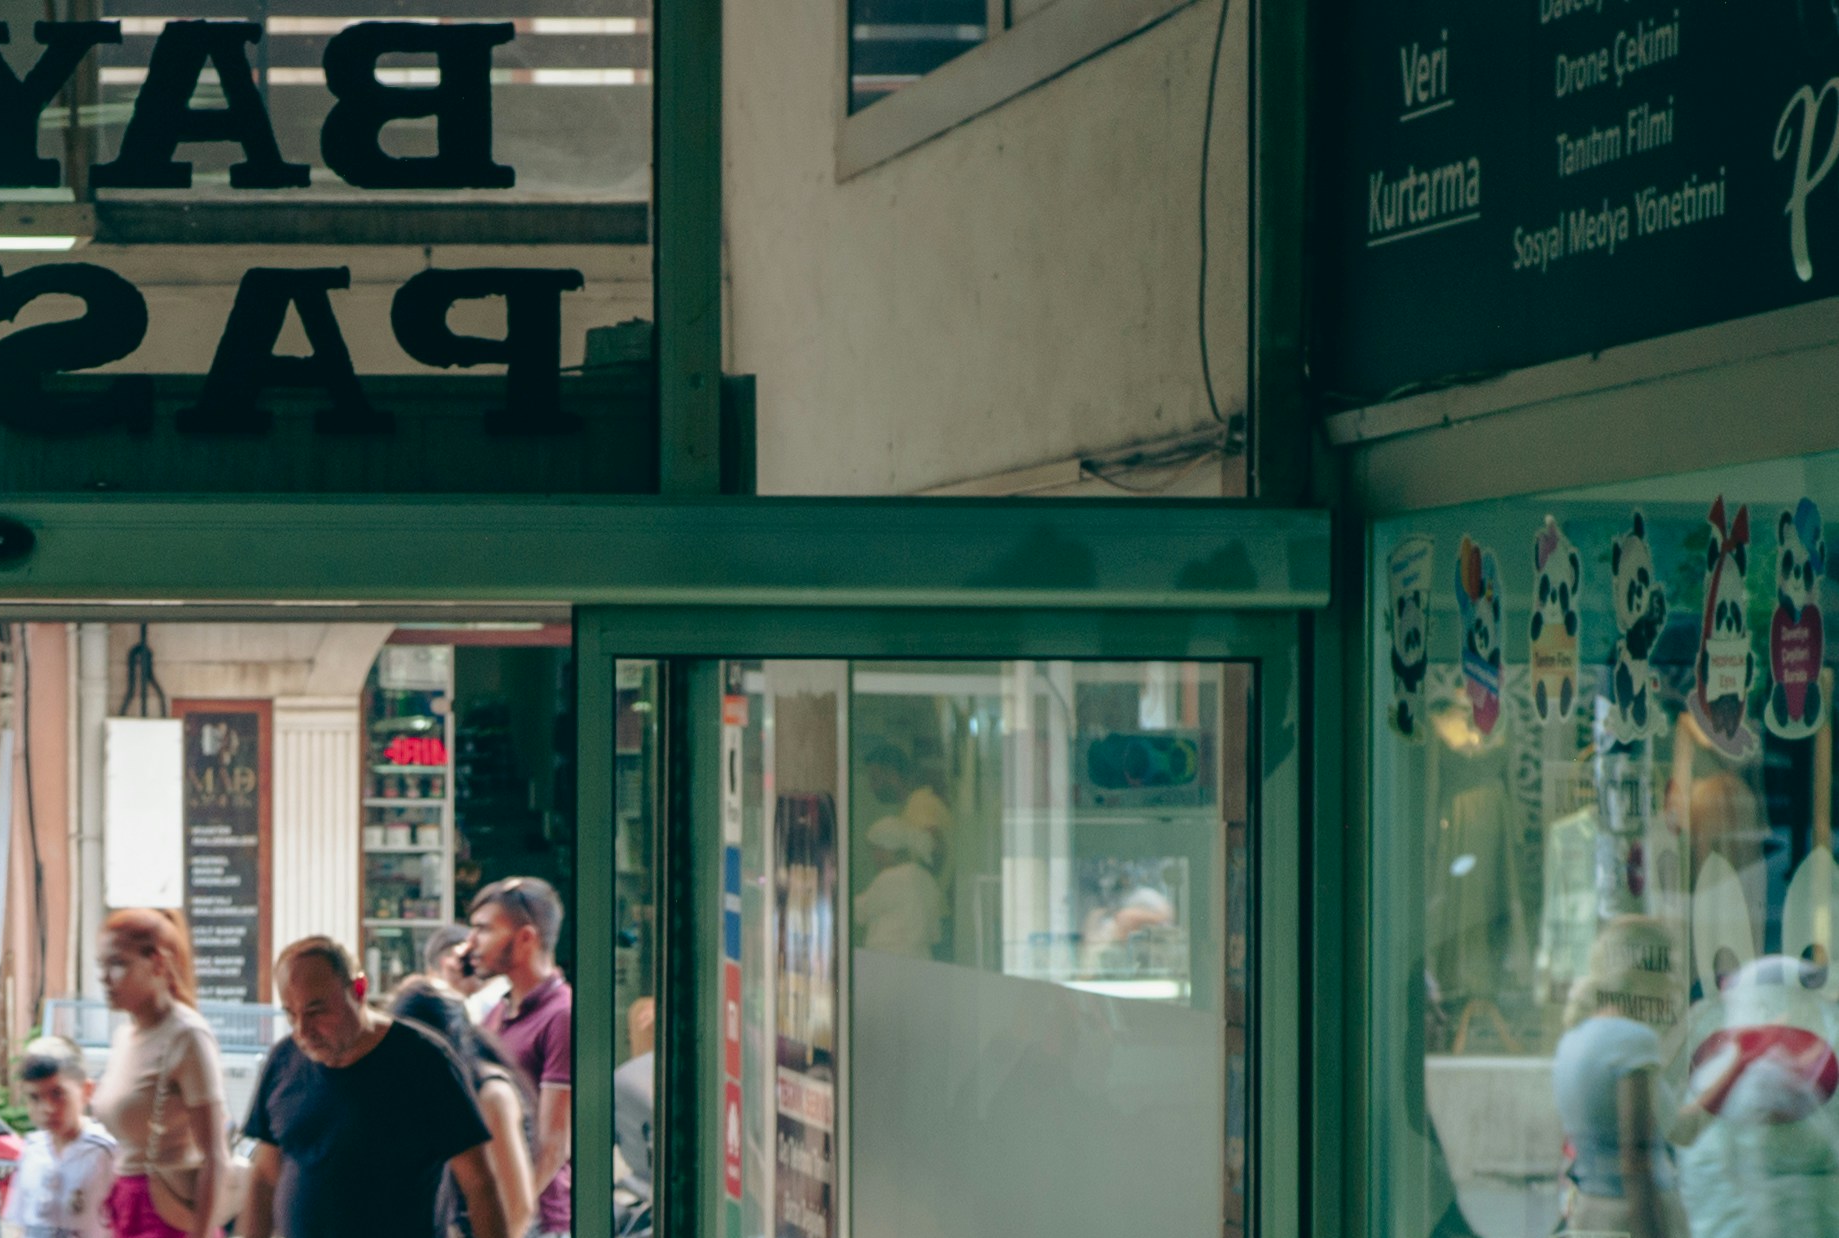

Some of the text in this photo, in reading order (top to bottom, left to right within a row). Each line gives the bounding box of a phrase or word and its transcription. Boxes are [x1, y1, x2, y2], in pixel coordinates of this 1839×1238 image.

[1400, 29, 1449, 107] Veri
[1556, 8, 1679, 98] Drone Çekimi
[1556, 95, 1674, 178] Tanıtım Filmi
[1367, 157, 1481, 234] Kurtarma
[1513, 165, 1725, 273] Sosyal Medya Yönetimi
